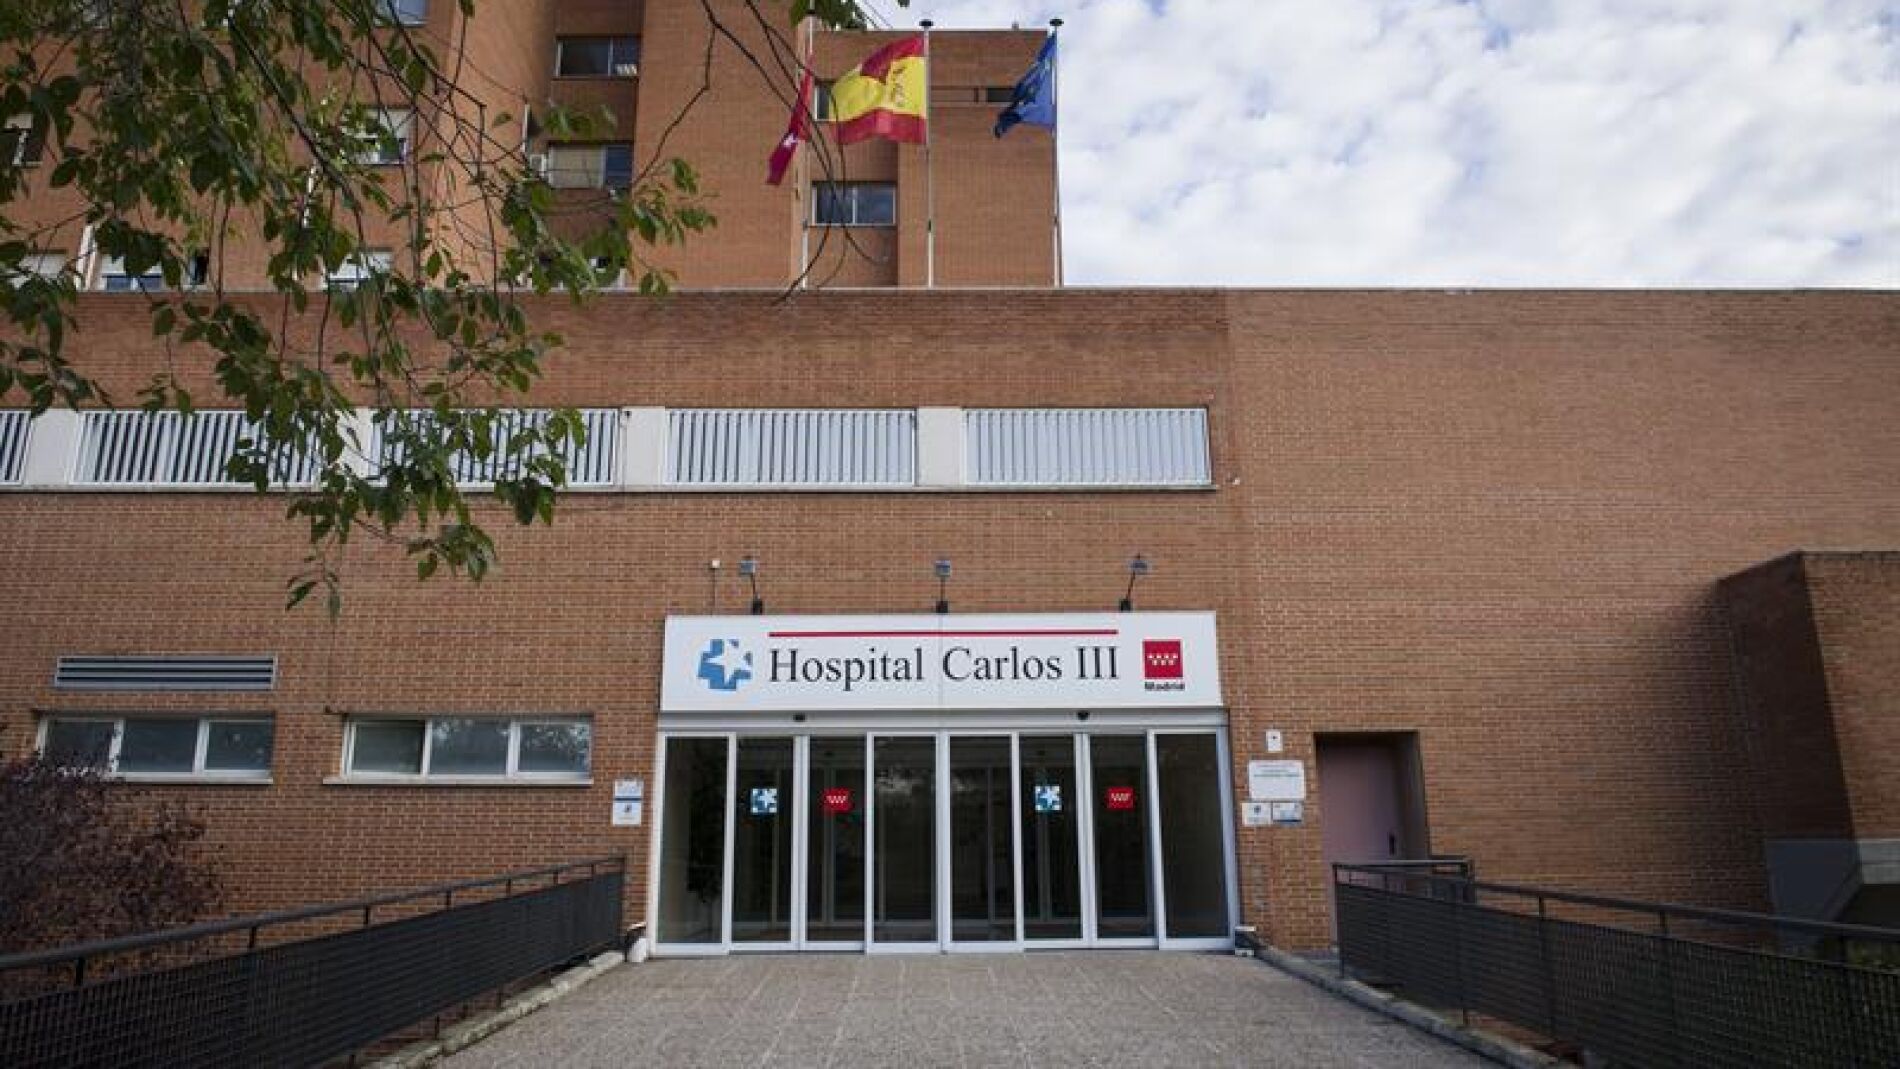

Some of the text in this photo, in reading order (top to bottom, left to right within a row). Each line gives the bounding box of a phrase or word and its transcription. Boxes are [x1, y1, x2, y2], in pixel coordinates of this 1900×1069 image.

[769, 646, 1119, 692] Hospital Carlos III
